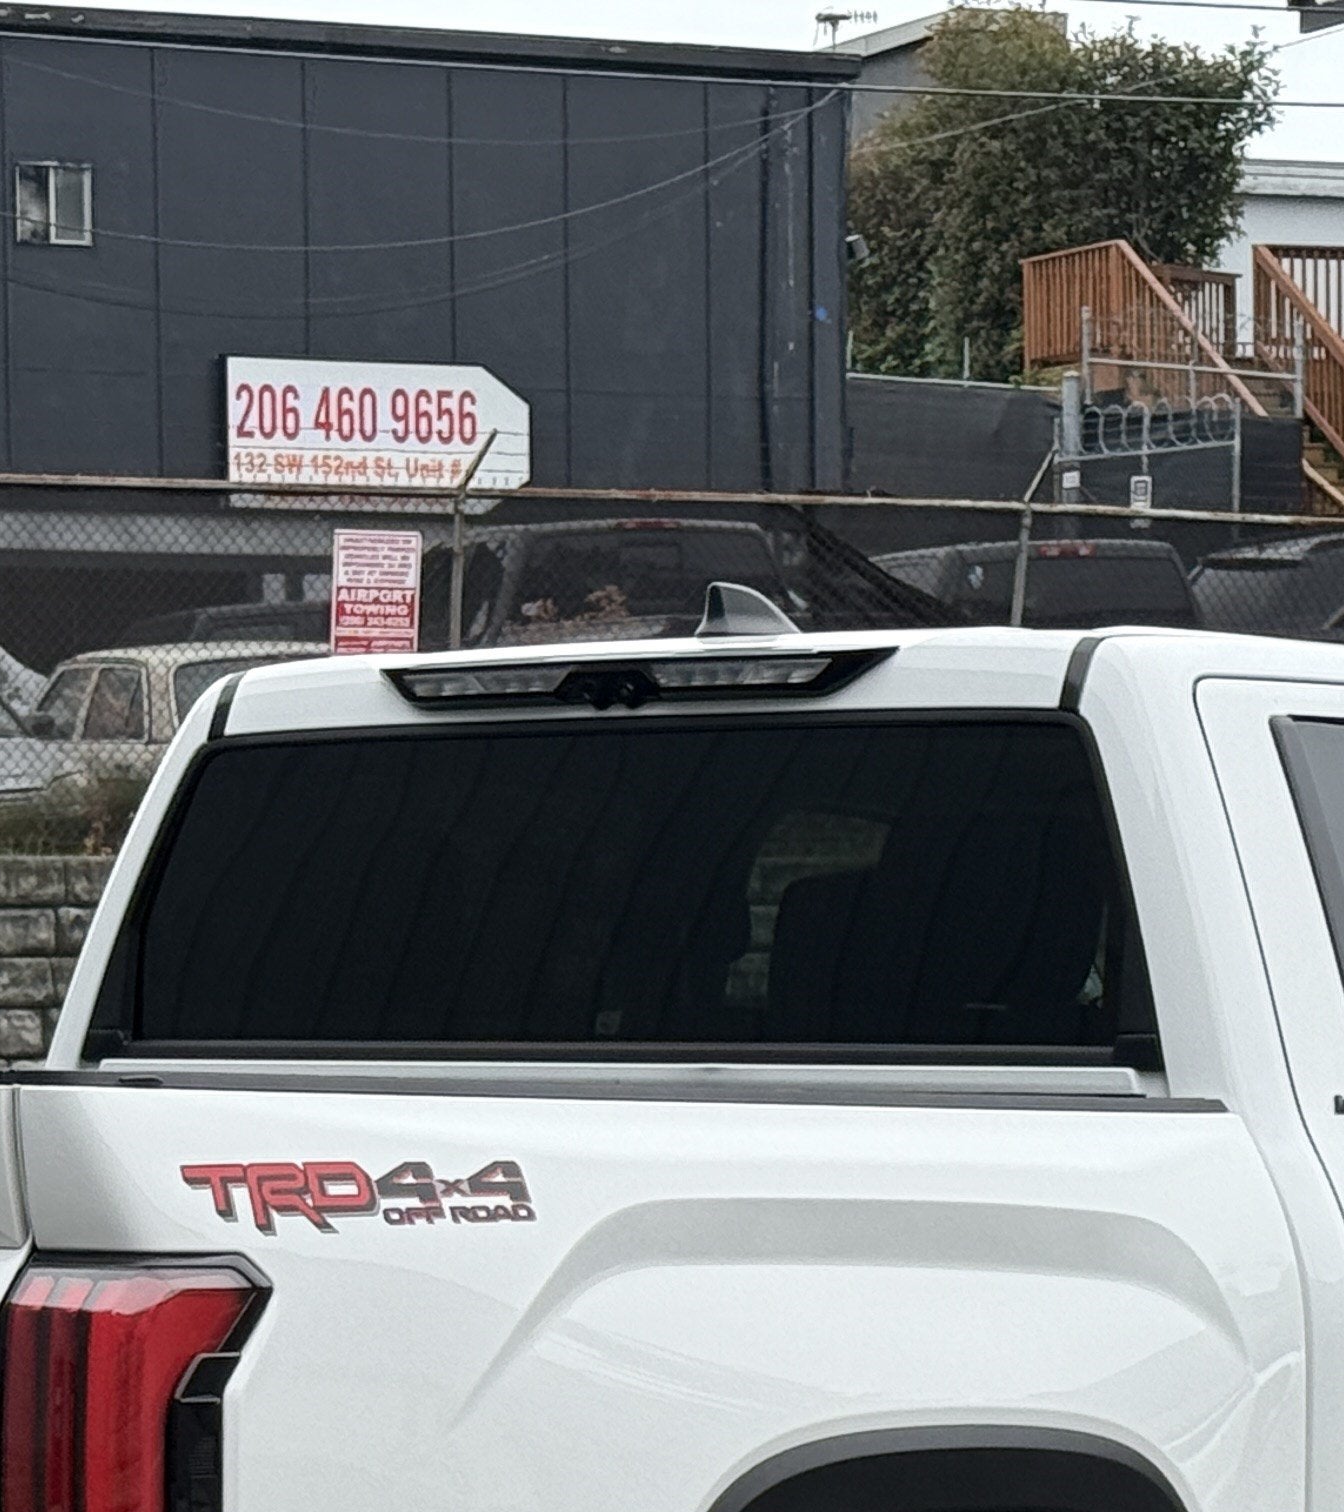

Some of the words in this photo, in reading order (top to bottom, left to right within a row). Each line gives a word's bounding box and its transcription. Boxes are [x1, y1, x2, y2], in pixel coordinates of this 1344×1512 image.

[235, 383, 301, 441] 206
[314, 386, 378, 443] 460
[391, 388, 478, 446] 9656
[233, 451, 268, 474] 132
[273, 452, 305, 476] SW
[310, 454, 369, 477] 152nd
[406, 456, 446, 480] Unit
[337, 588, 415, 603] AIRPORT
[180, 1161, 381, 1237] TRD
[383, 1203, 446, 1226] OFF
[449, 1203, 537, 1225] ROAD
